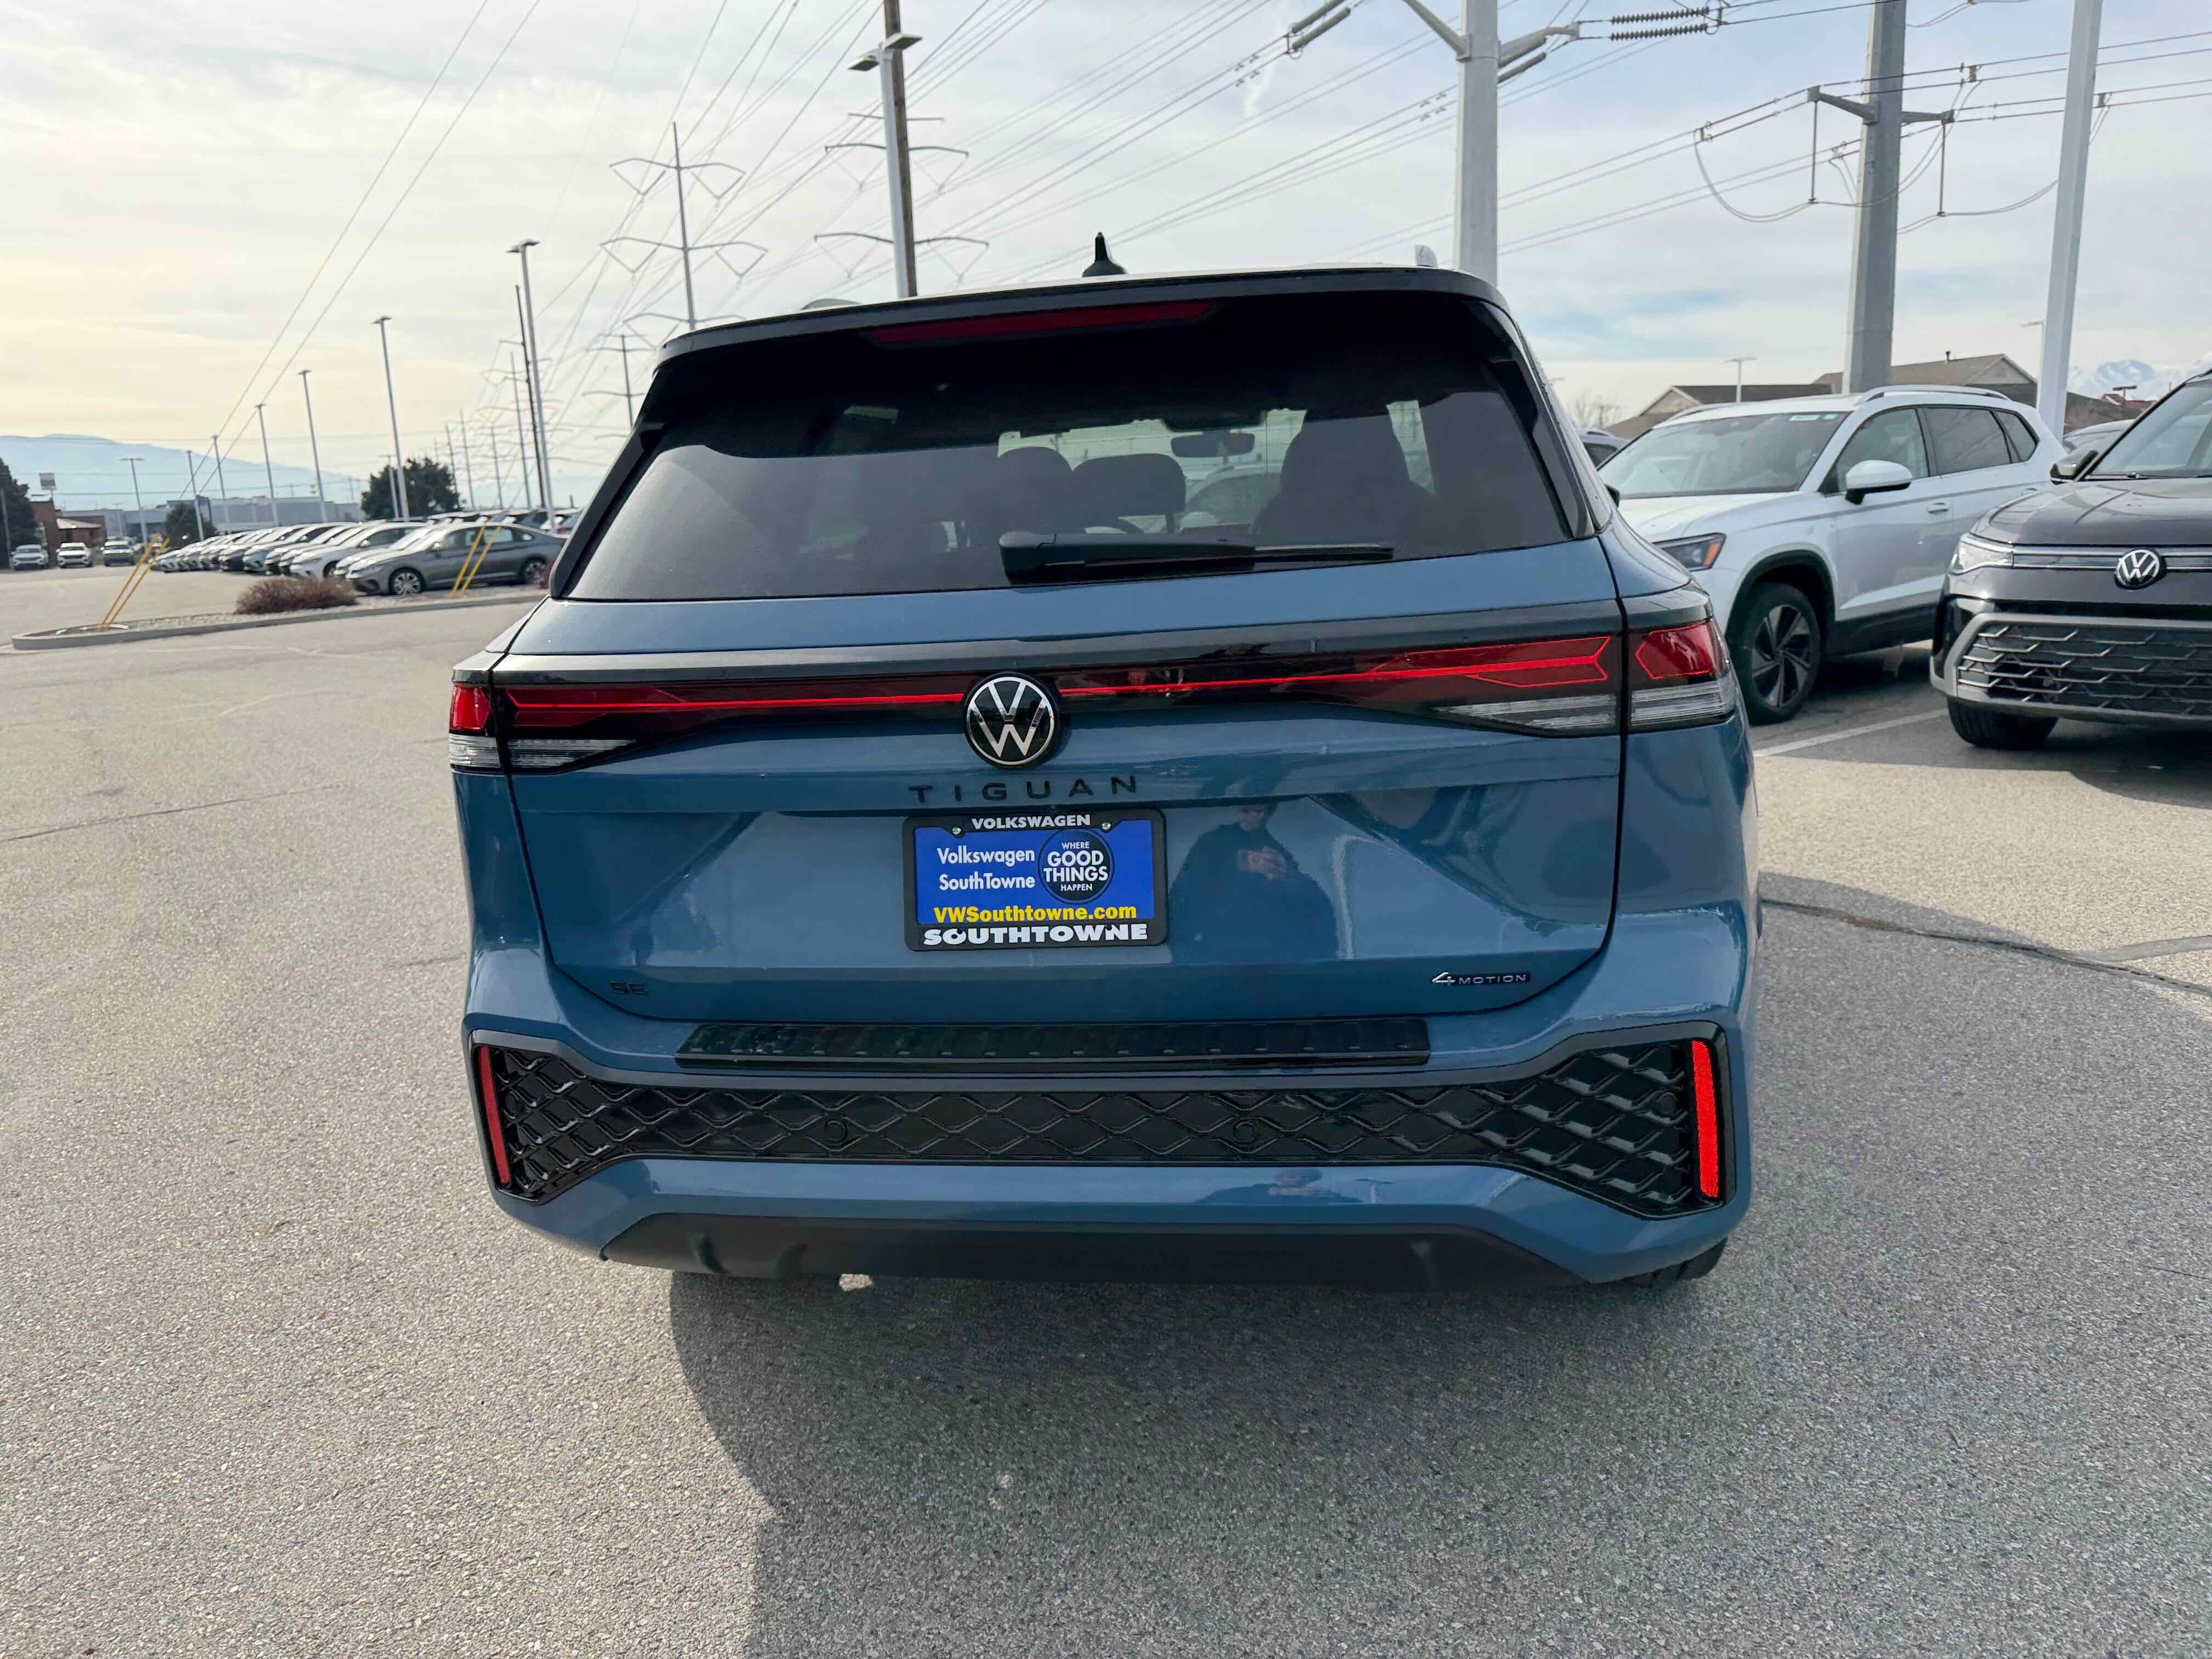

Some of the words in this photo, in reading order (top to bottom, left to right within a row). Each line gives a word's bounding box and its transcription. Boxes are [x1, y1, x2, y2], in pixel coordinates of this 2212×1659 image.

[909, 775, 1136, 804] TIGUAN
[972, 814, 1091, 830] VOLKSWAGEN
[1061, 841, 1090, 850] WHERE
[936, 845, 1036, 867] Volkswagen
[1047, 850, 1104, 867] GOOD
[1043, 866, 1109, 883] THINGS
[1060, 883, 1093, 892] HAPPEN
[934, 905, 1137, 923] VWSouthtowne.com
[923, 923, 1148, 946] SOUTHTOWNE
